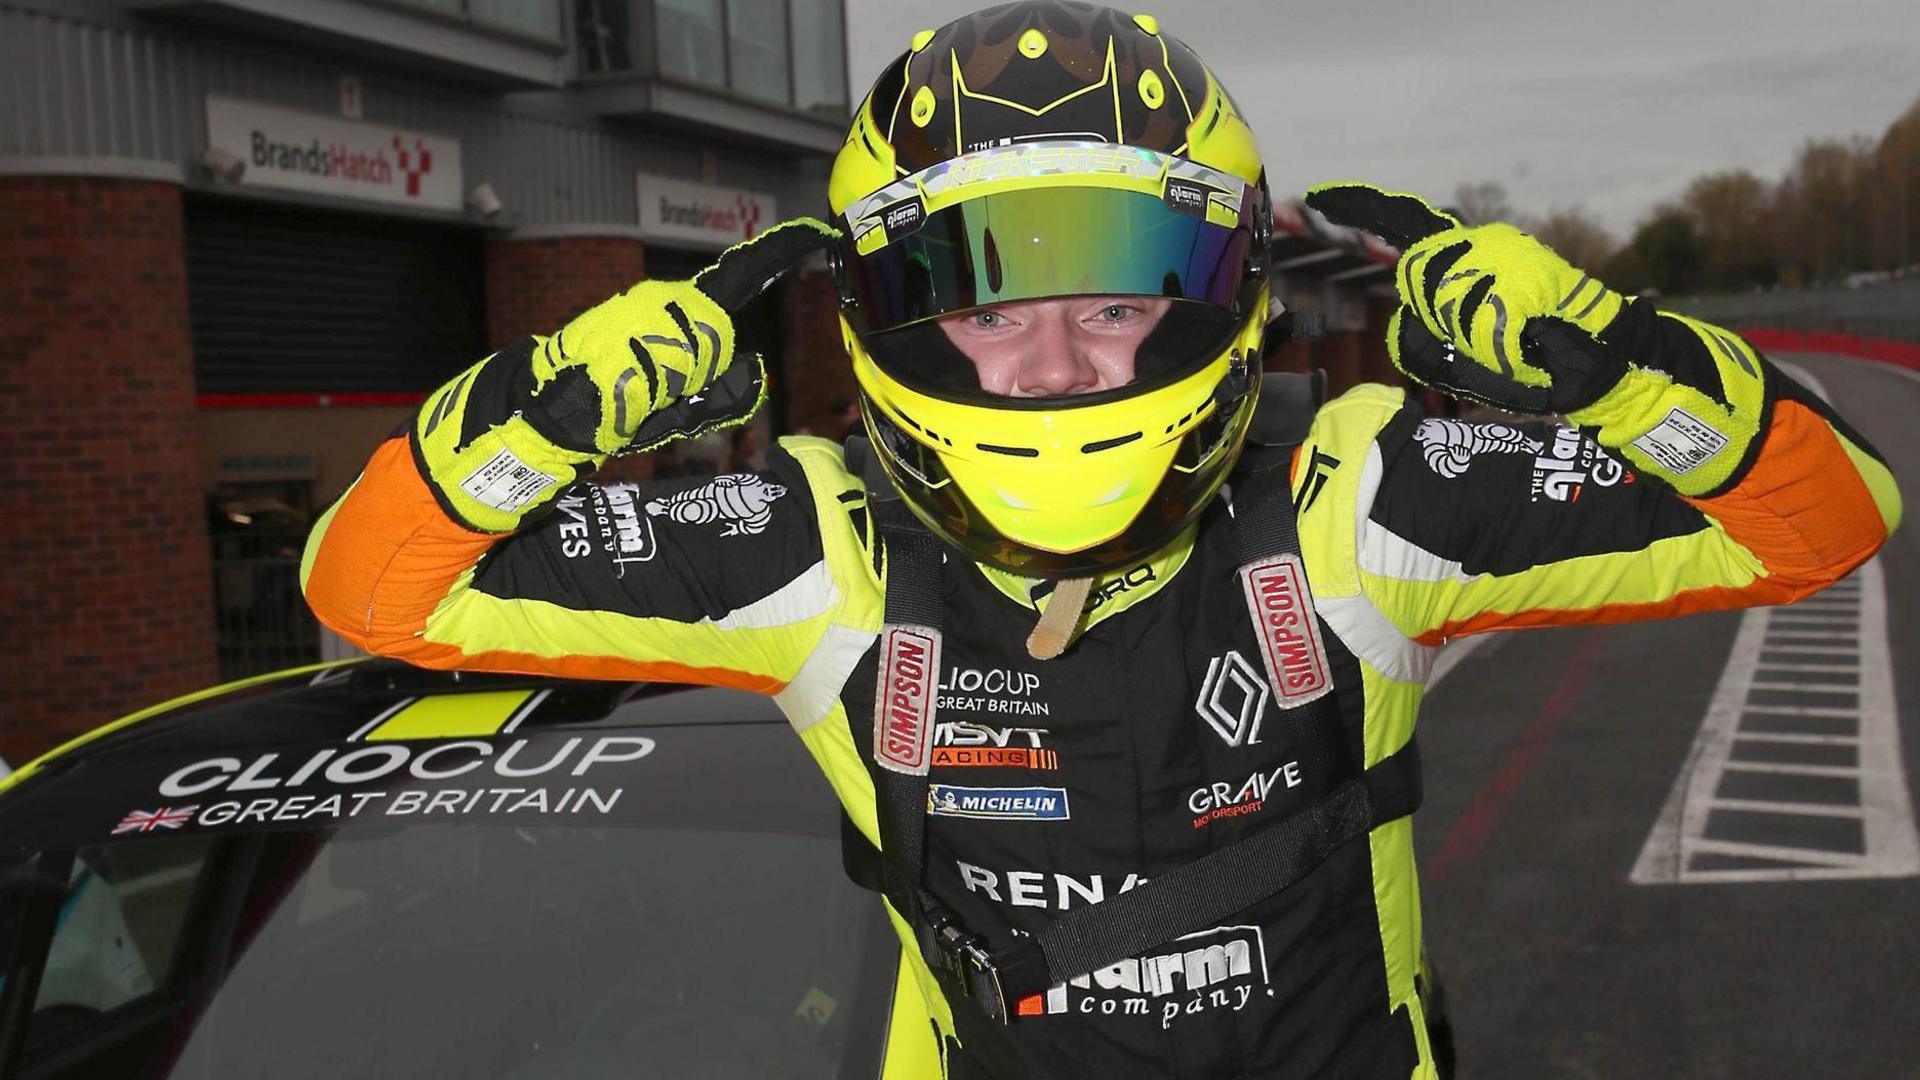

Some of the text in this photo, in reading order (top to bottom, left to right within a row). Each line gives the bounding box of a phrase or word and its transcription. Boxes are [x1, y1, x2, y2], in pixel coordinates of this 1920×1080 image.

[251, 129, 393, 186] BrandsHatch
[1531, 470, 1545, 495] THE
[1259, 574, 1316, 689] SIMPSON
[939, 667, 1040, 696] IOCUP
[888, 640, 925, 760] SIMPSON
[936, 696, 1050, 716] GREAT BRITAIN
[159, 736, 656, 798] CLIOCUP
[936, 750, 1026, 764] ACING
[198, 788, 623, 826] GREAT BRITAIN
[963, 796, 1057, 812] MICHELIN
[1192, 801, 1263, 829] MOTORSPORT
[1080, 983, 1252, 1030] company
